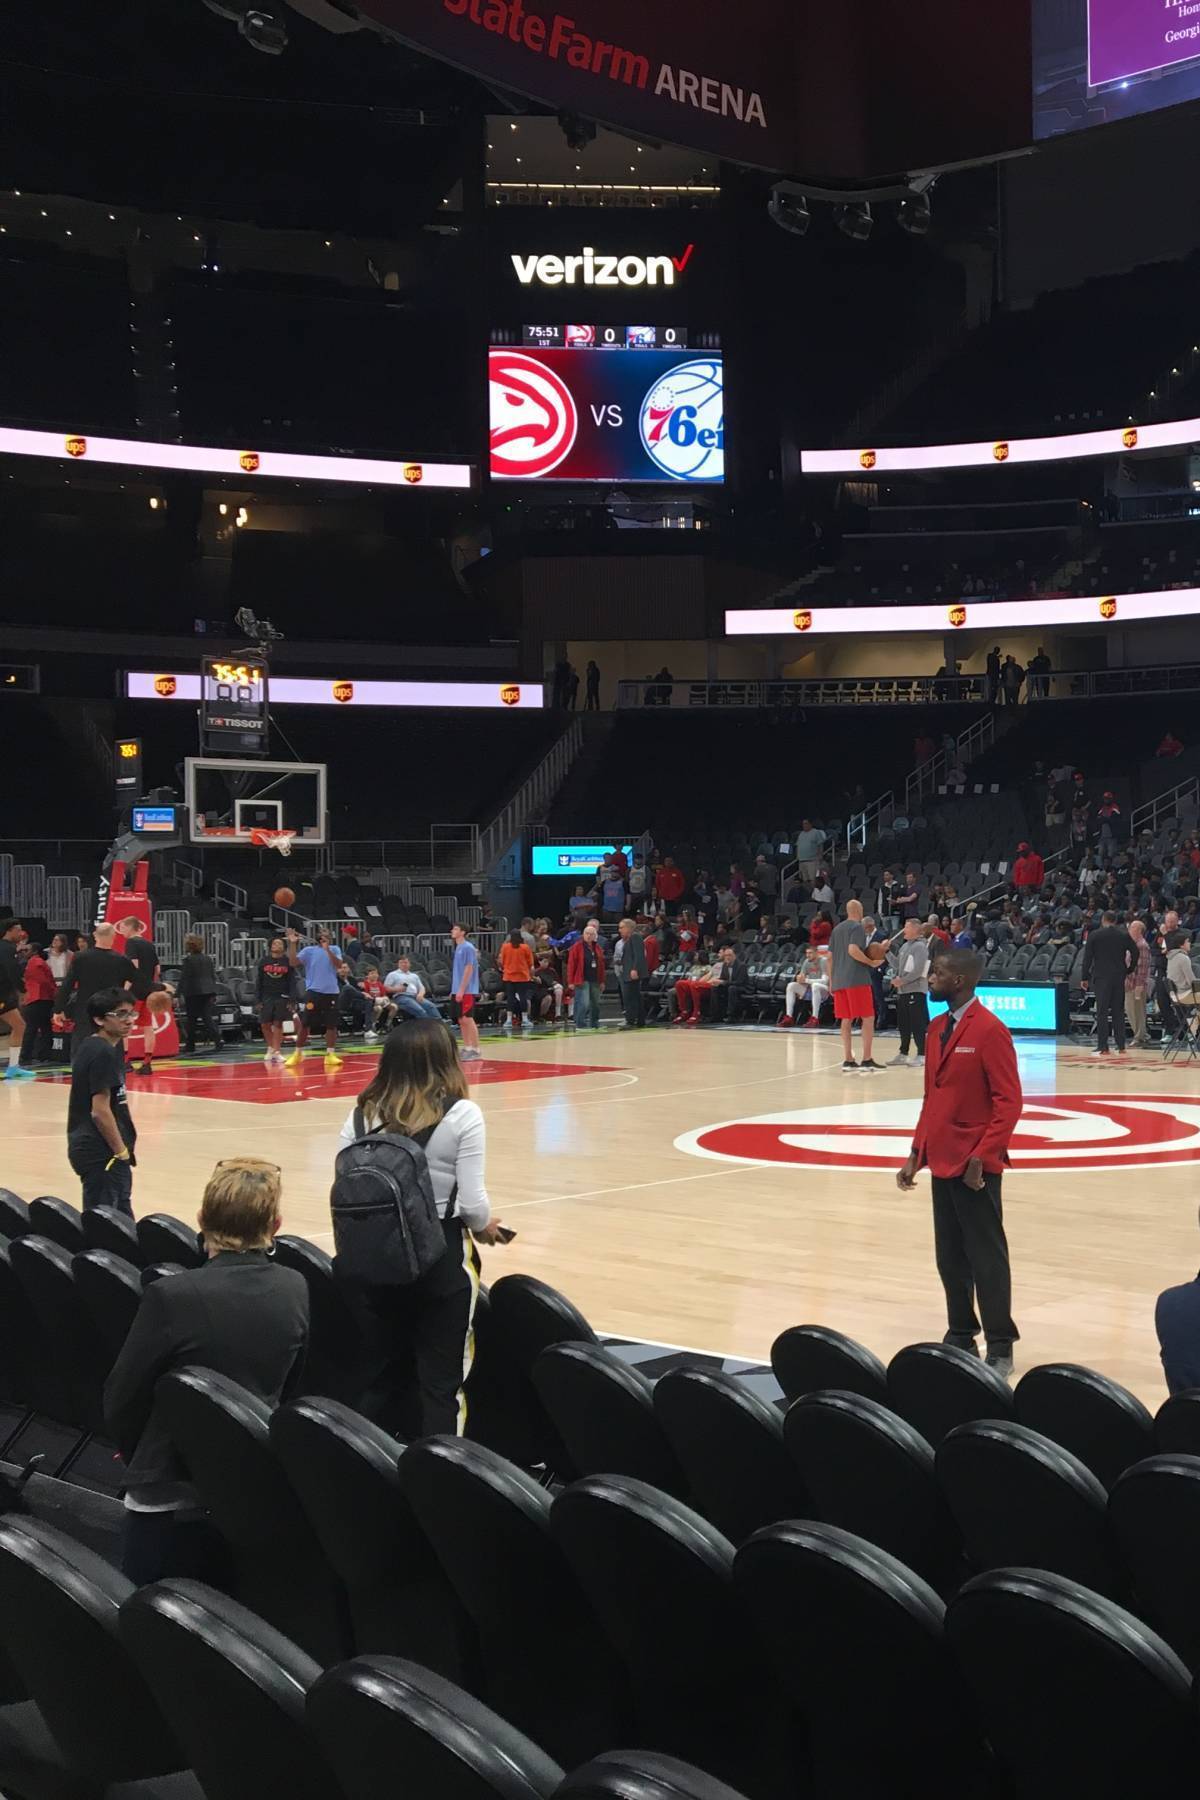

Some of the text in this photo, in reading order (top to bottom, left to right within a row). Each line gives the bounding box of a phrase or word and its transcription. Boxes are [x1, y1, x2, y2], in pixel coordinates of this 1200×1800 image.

[654, 63, 767, 128] ARENA
[511, 247, 674, 285] verizon
[528, 326, 559, 337] 75:51
[604, 328, 615, 342] 0
[665, 328, 676, 342] 0
[590, 404, 623, 427] VS
[1123, 434, 1137, 446] ups
[67, 442, 85, 454] ups
[994, 447, 1008, 459] ups
[241, 457, 258, 469] ups
[861, 455, 875, 467] ups
[406, 469, 421, 481] ups
[1100, 603, 1116, 616] ups
[794, 615, 811, 628] ups
[950, 610, 966, 624] ups
[155, 680, 175, 694] ups
[334, 686, 352, 700] ups
[502, 690, 519, 702] ups
[225, 717, 263, 729] TISSOT
